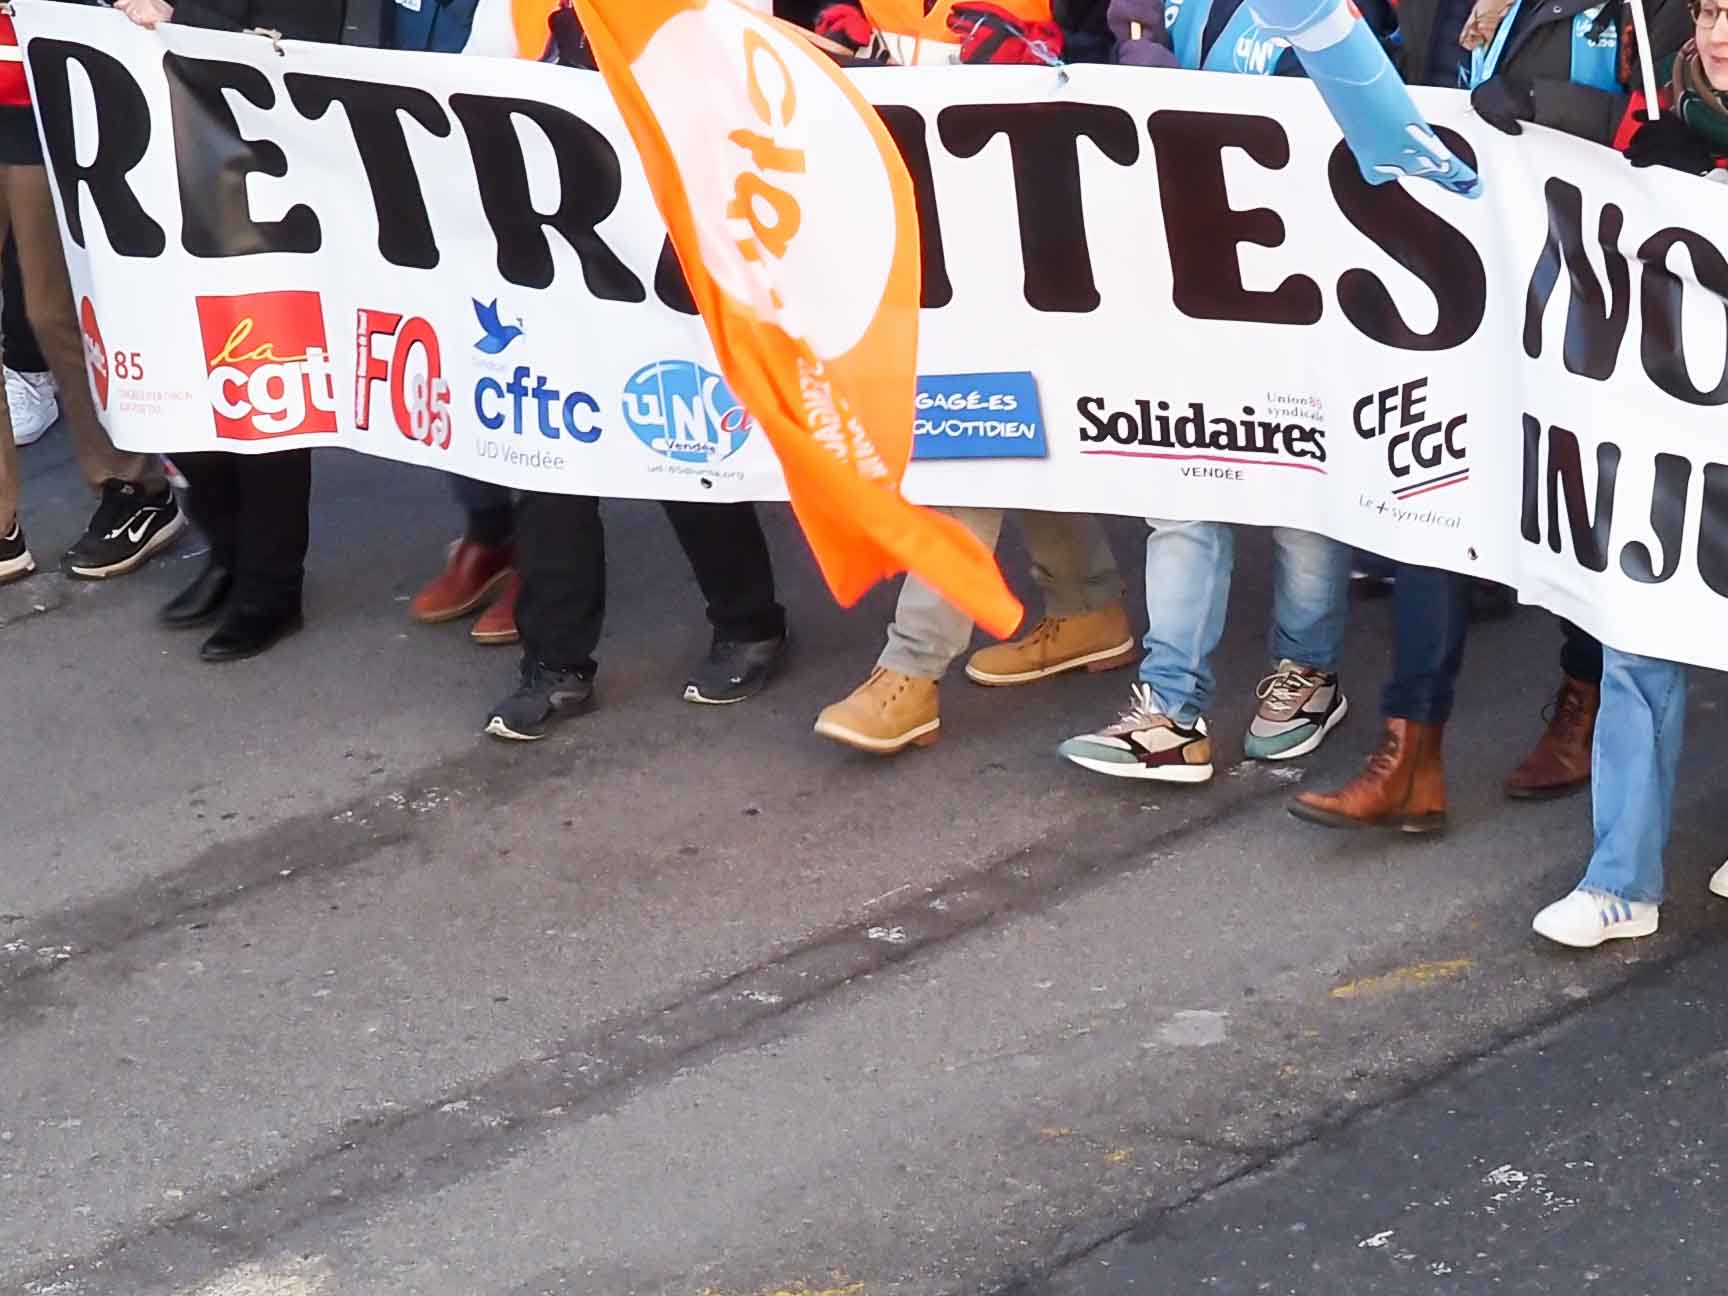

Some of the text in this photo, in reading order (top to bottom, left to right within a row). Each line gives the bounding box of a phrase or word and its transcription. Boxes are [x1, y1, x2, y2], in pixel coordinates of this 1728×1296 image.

[26, 37, 1487, 353] RETRTES
[114, 350, 145, 381] 85
[208, 345, 337, 434] cgt
[355, 307, 452, 450] FO 85
[474, 365, 603, 444] cftc
[912, 419, 1036, 439] QUOTIDIEN
[1078, 395, 1326, 463] Solidaires
[1352, 376, 1429, 440] CFE
[502, 447, 565, 471] Vendée
[1180, 462, 1246, 482] VENDÉE
[1387, 413, 1468, 478] CGC
